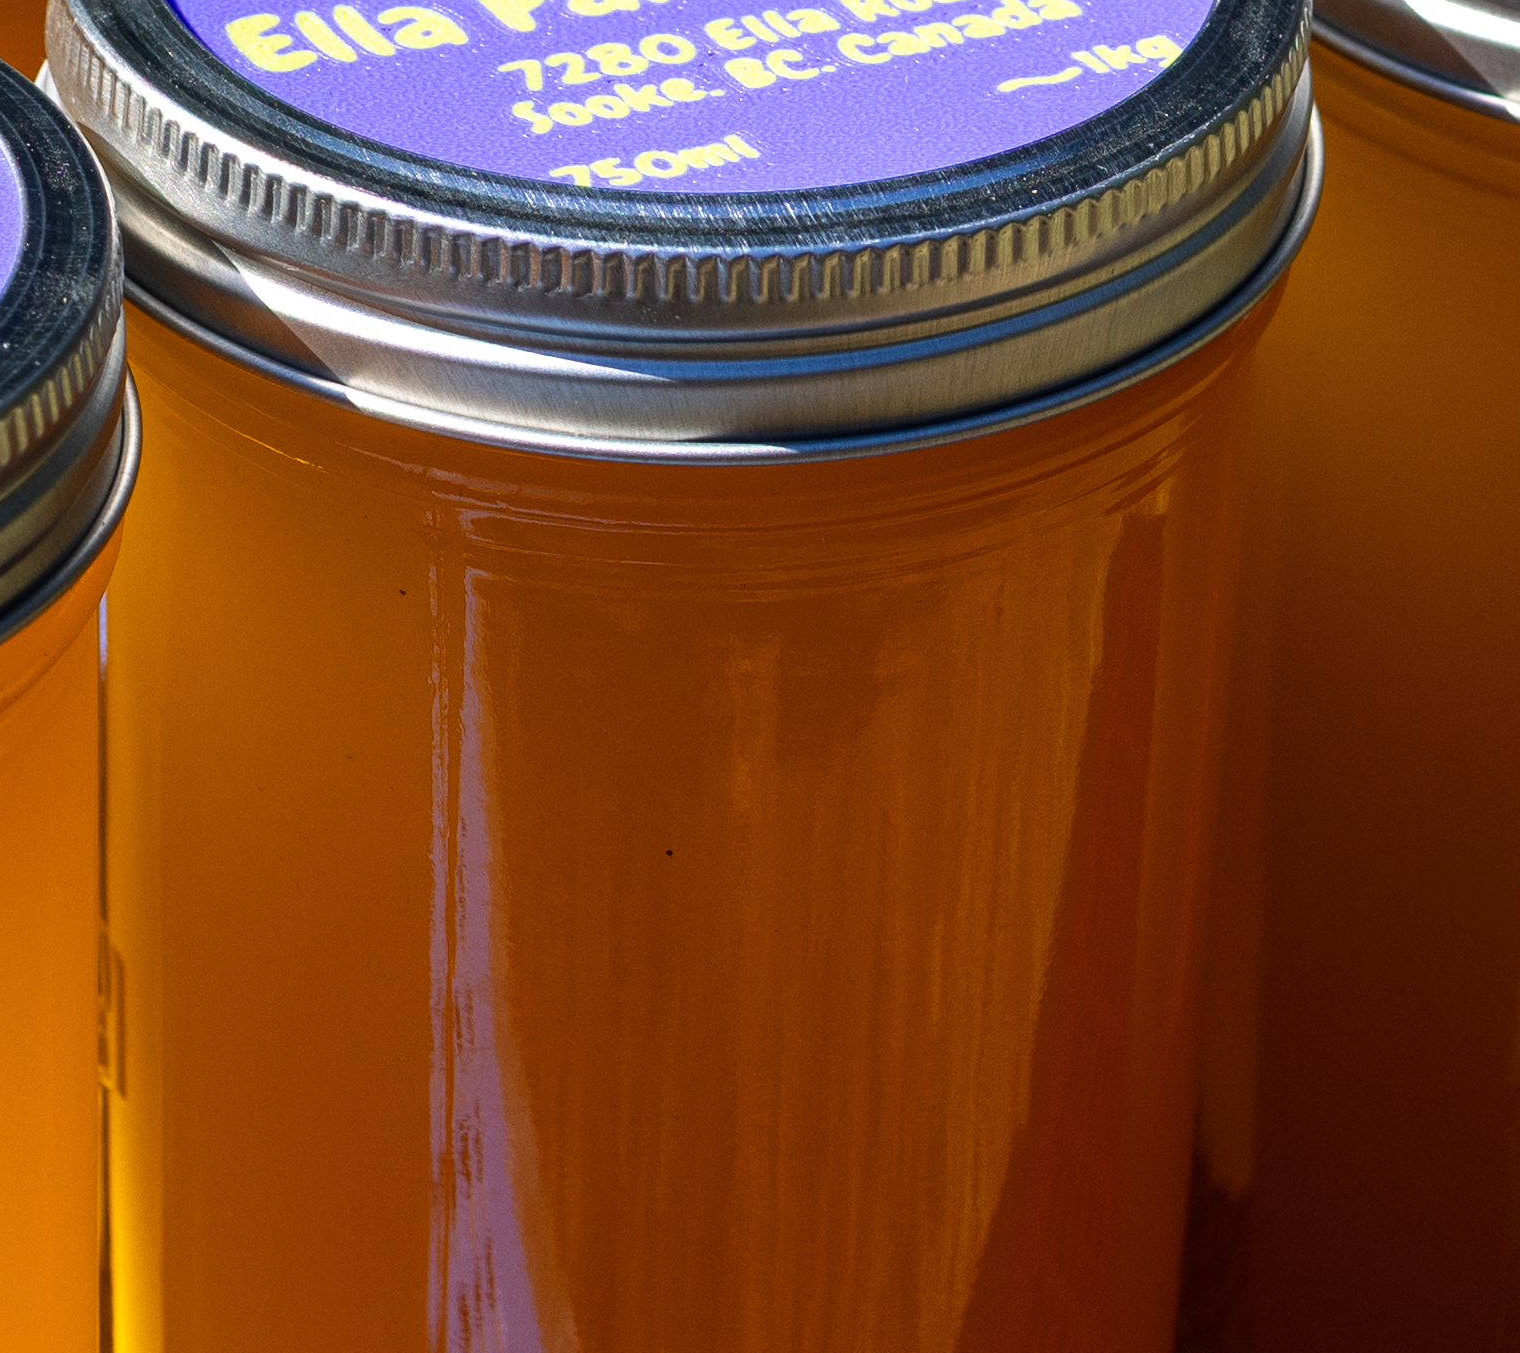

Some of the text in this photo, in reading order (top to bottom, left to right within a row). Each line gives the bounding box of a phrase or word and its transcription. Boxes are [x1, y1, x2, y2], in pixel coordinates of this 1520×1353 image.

[226, 6, 468, 71] Ella
[499, 35, 695, 90] 7280
[705, 10, 840, 50] Ella
[550, 136, 759, 187] 750ml
